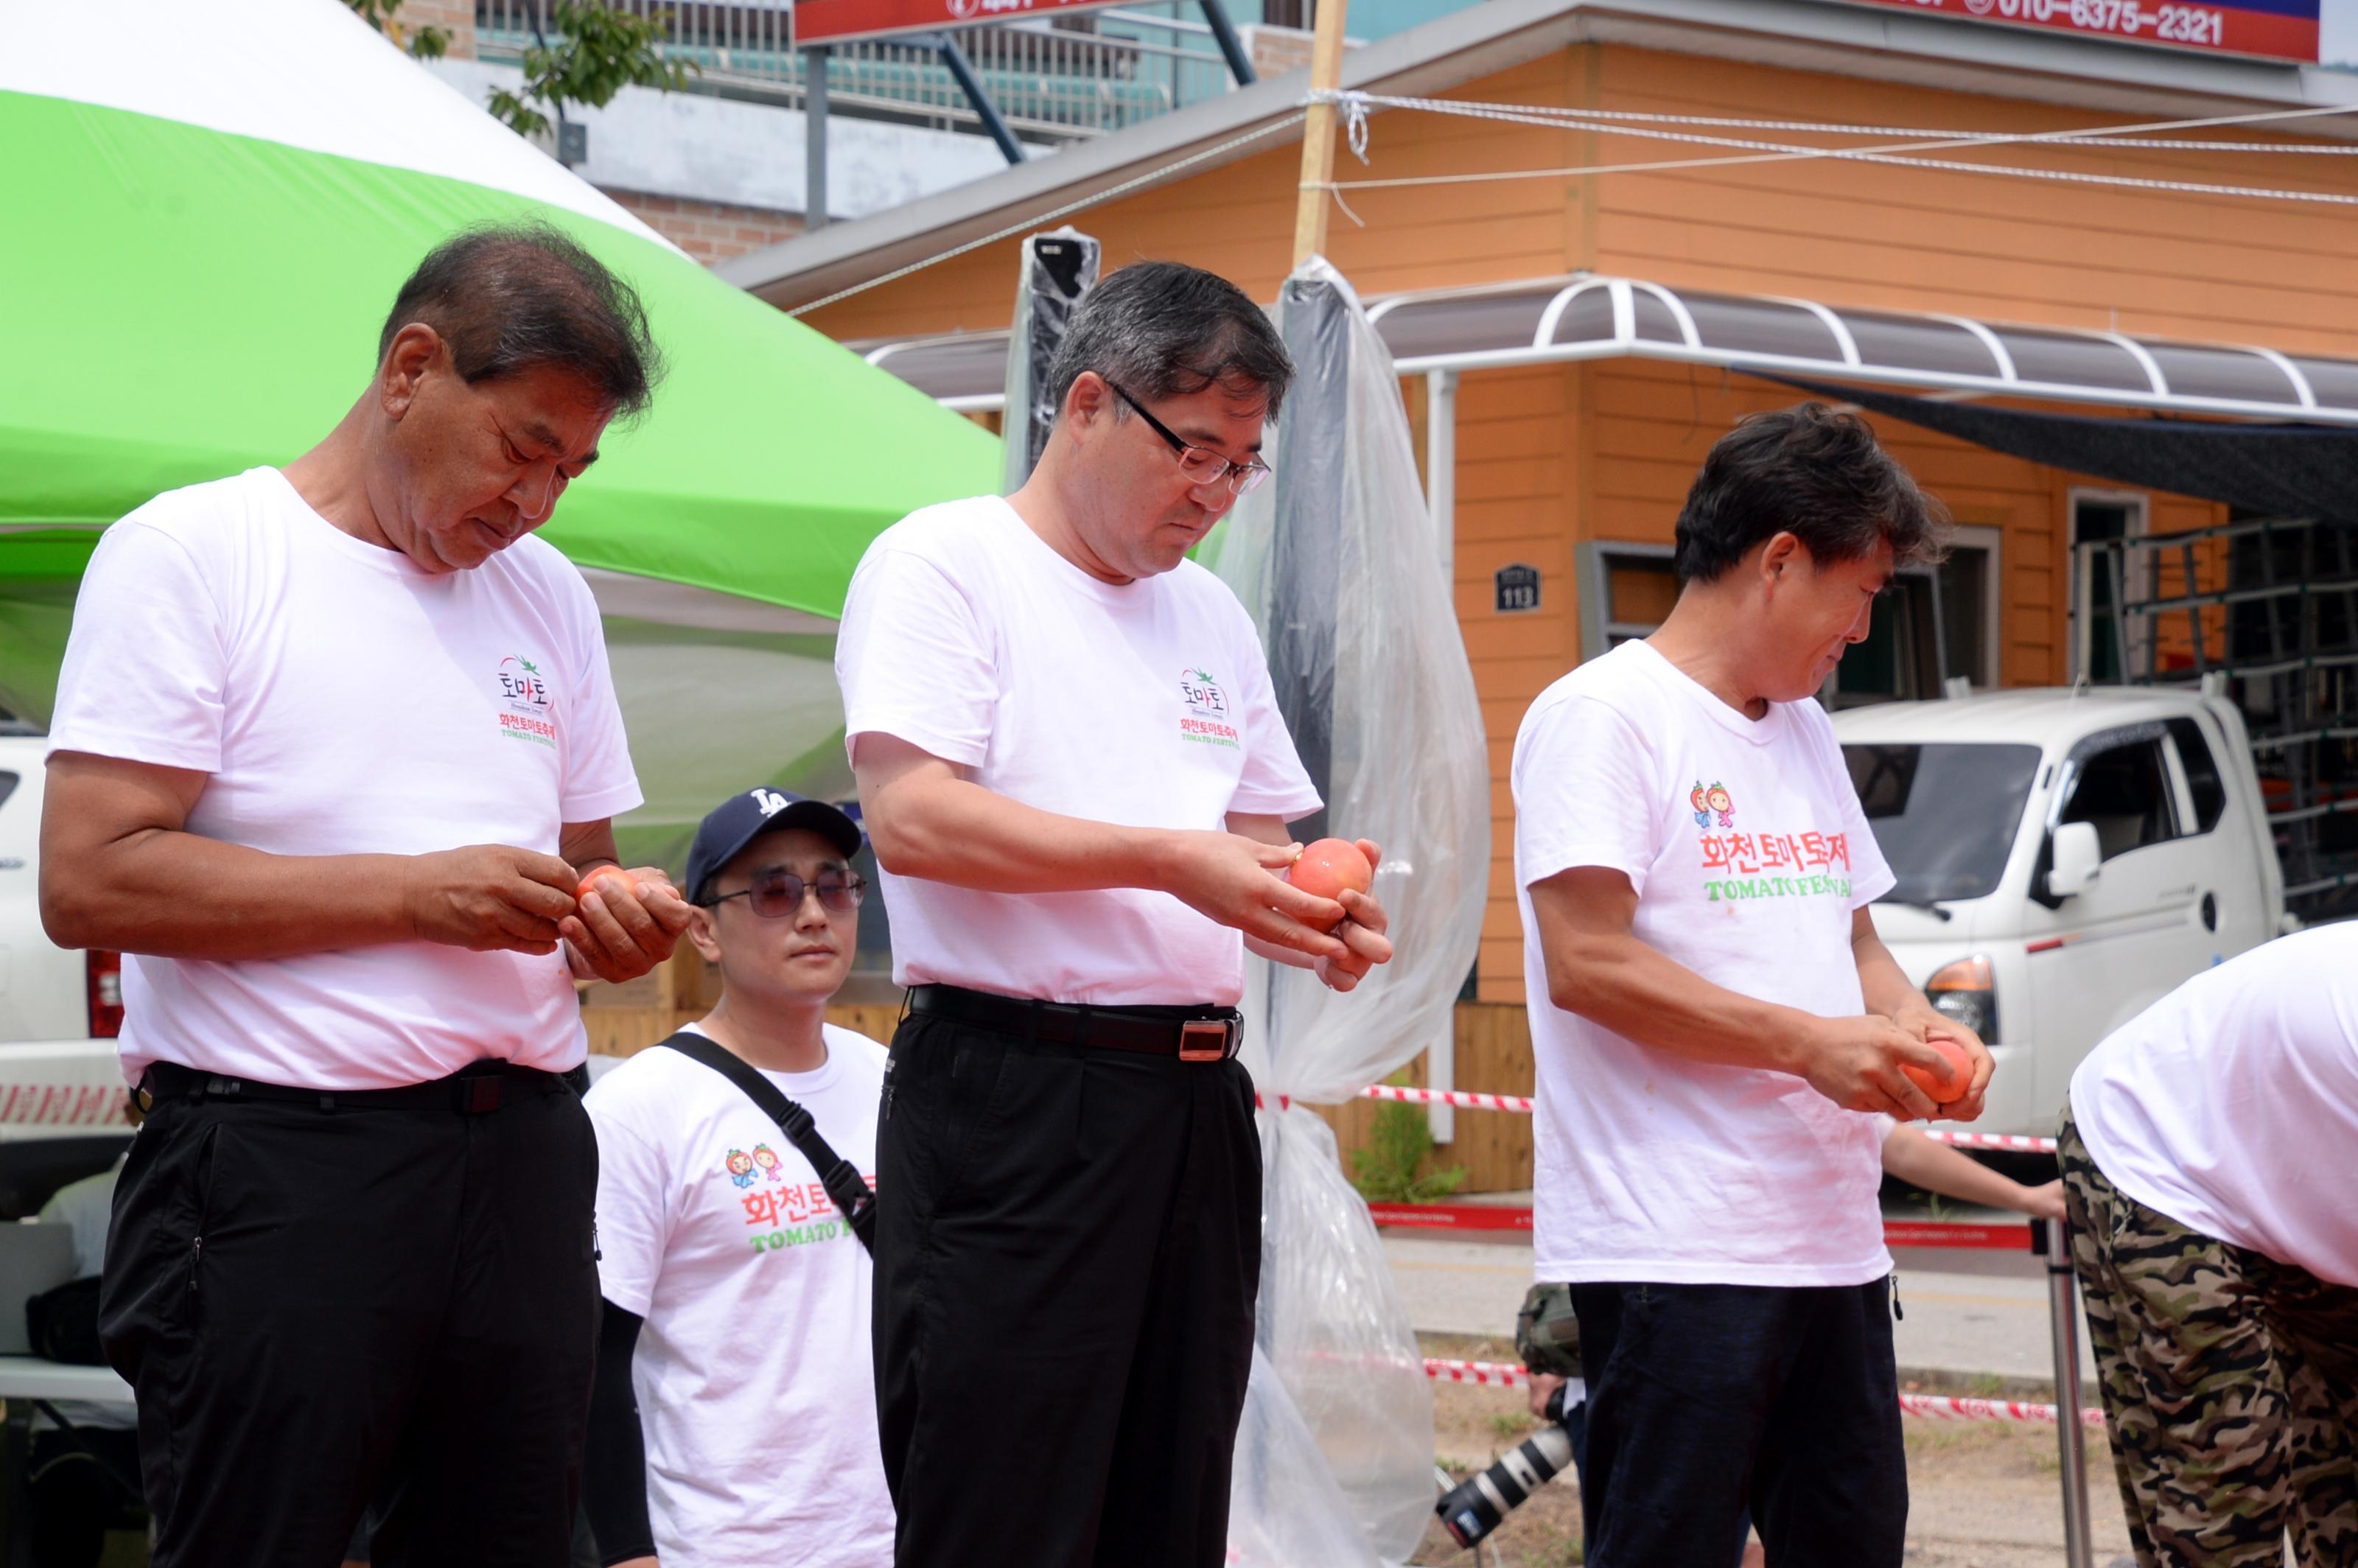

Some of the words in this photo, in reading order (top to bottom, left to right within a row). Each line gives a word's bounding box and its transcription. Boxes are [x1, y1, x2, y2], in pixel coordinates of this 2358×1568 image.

[498, 673, 547, 705] 토마토
[1180, 682, 1225, 710] 토마토
[750, 788, 791, 819] LA
[749, 1221, 836, 1253] TOMATO
